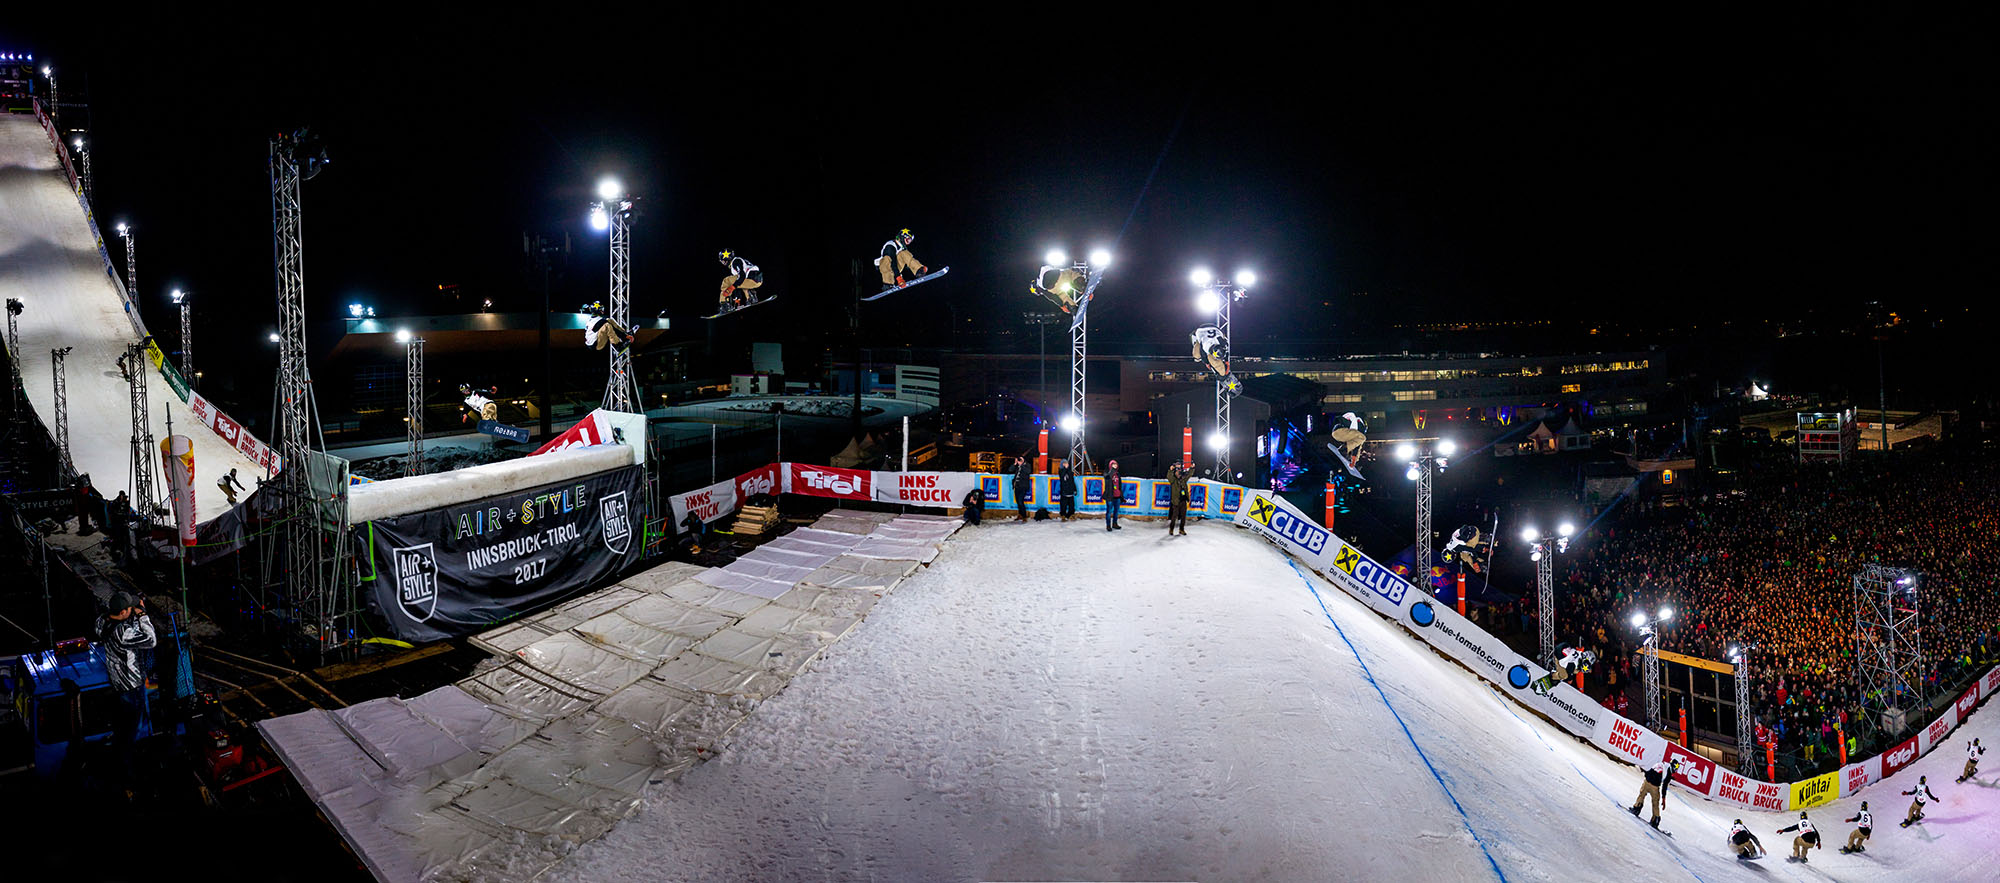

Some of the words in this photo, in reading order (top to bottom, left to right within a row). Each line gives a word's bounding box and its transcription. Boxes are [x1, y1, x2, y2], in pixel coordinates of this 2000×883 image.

[800, 470, 862, 494] Tirol
[898, 474, 940, 488] INNS'
[899, 488, 952, 502] BRUCK
[695, 502, 720, 520] RUCK
[606, 514, 627, 536] STYLE
[1242, 518, 1252, 530] Da
[1271, 511, 1325, 553] CLUB
[466, 522, 581, 570] INNSBRUCK-TIROL
[514, 558, 547, 585] 2017
[1329, 567, 1337, 578] Da
[1354, 561, 1404, 603] CLUB
[404, 572, 432, 601] STYLE
[1434, 618, 1505, 672] blue-tomato.com
[1612, 718, 1642, 742] INNS'
[1929, 722, 1949, 744] BRUCK
[1608, 731, 1646, 761] BRUCK
[1886, 742, 1915, 768] Tirol
[1722, 771, 1748, 790] INNS'
[1757, 783, 1781, 797] INNS'
[1798, 777, 1831, 805] Kühtai
[1848, 774, 1869, 792] BRUCK
[1719, 785, 1750, 804] BRUCK
[1752, 794, 1784, 811] BRUCK
[1863, 813, 1869, 823] 6
